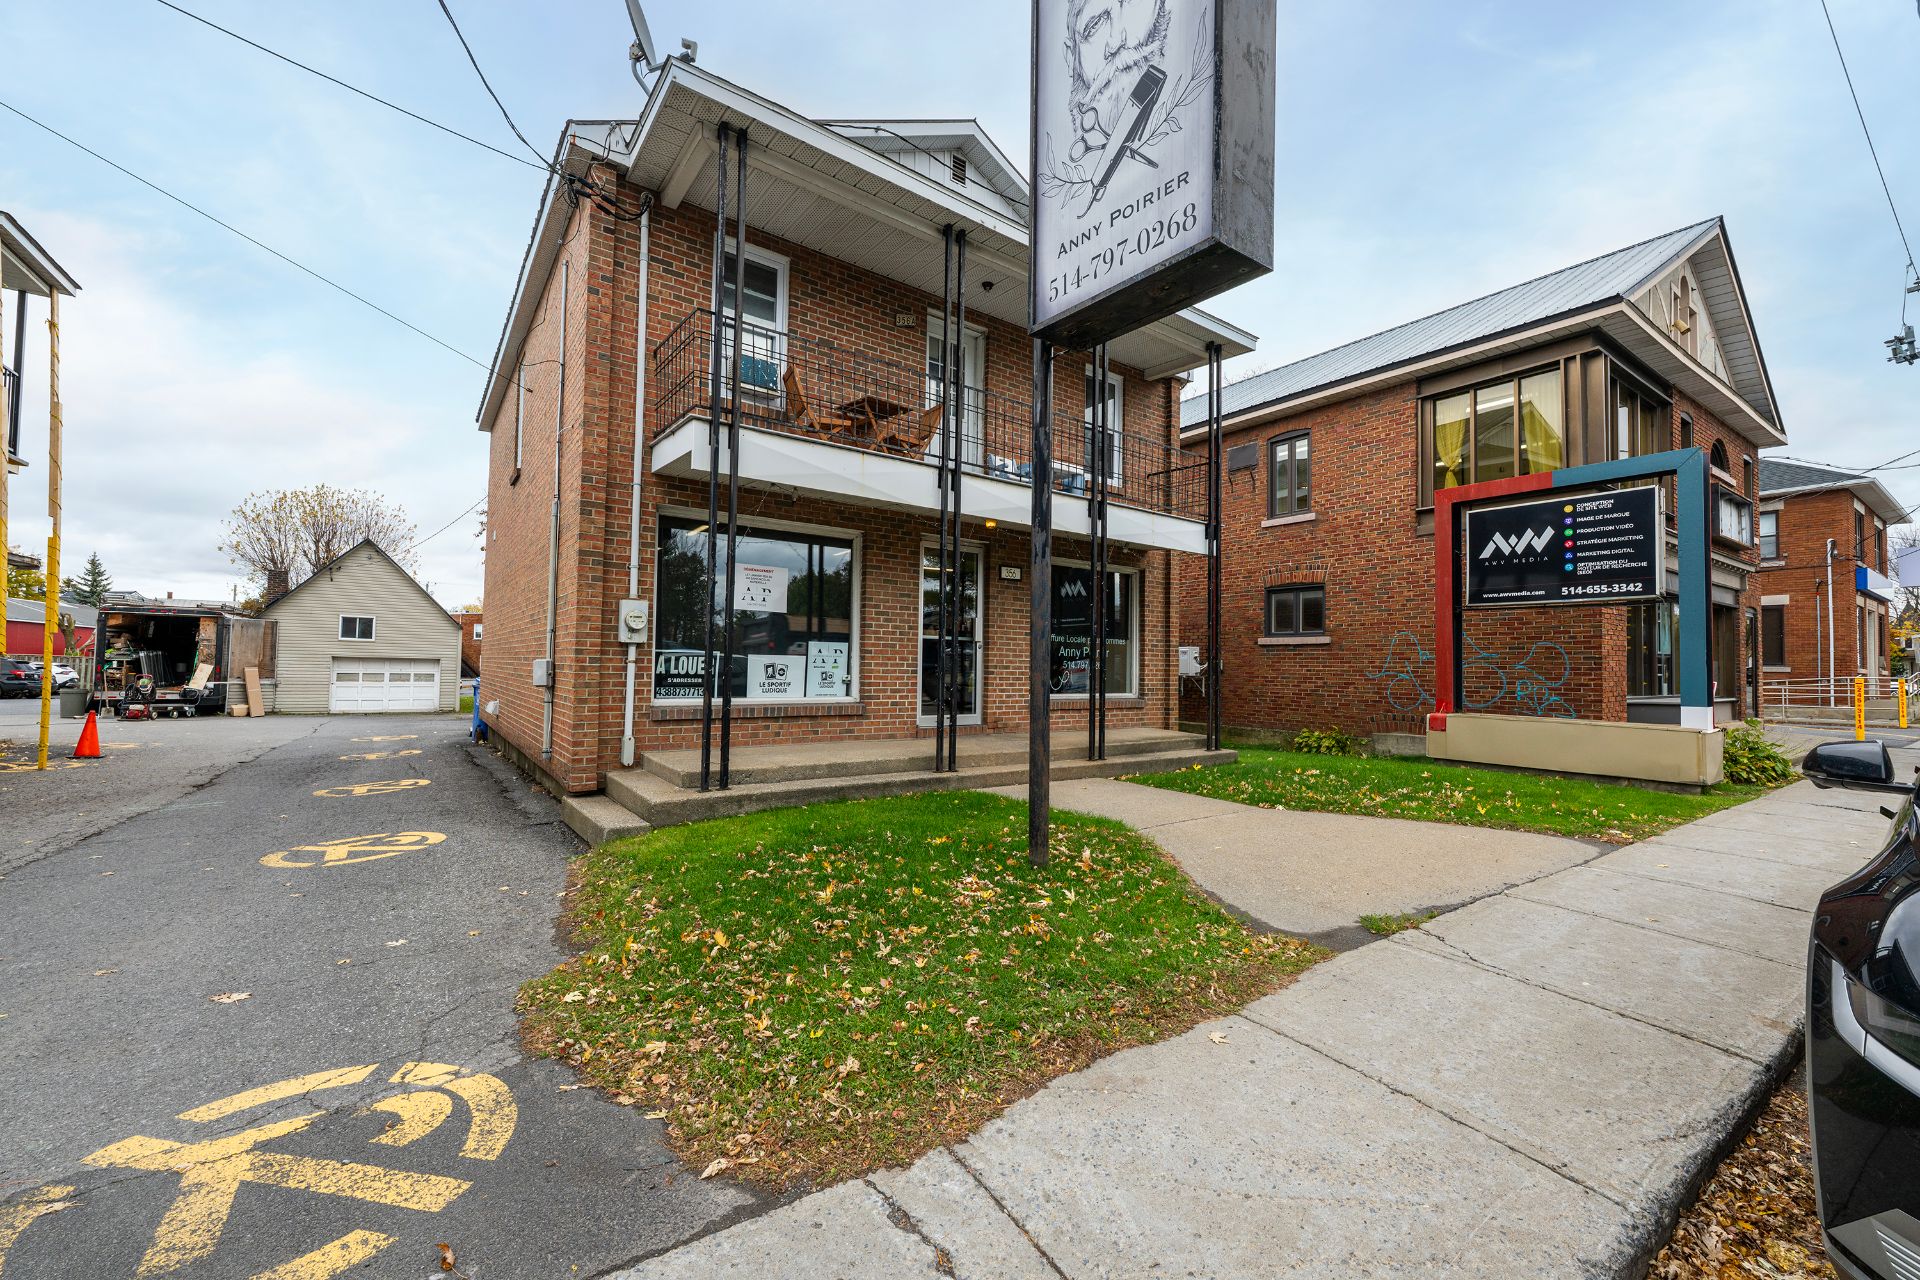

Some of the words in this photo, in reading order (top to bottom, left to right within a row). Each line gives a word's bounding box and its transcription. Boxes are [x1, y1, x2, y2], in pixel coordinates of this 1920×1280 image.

[1056, 220, 1103, 259] ANNY
[1109, 171, 1191, 229] POIRIER
[1048, 201, 1198, 304] 514-797-0268
[1576, 499, 1614, 508] CONCEPTION
[1576, 526, 1615, 534] PRODUCTION
[1576, 537, 1607, 545] STRATÉGIE
[1608, 534, 1644, 542] MARKETING
[1576, 549, 1610, 557] MARKETING
[1576, 560, 1617, 568] OPTIMISATION
[1611, 561, 1648, 569] RECHERCHE
[1004, 568, 1017, 579] 356
[1561, 583, 1643, 595] 514-655-3342
[1482, 590, 1545, 598] www.awvmedia.com
[1066, 635, 1086, 643] Locale
[1058, 645, 1081, 659] Anny
